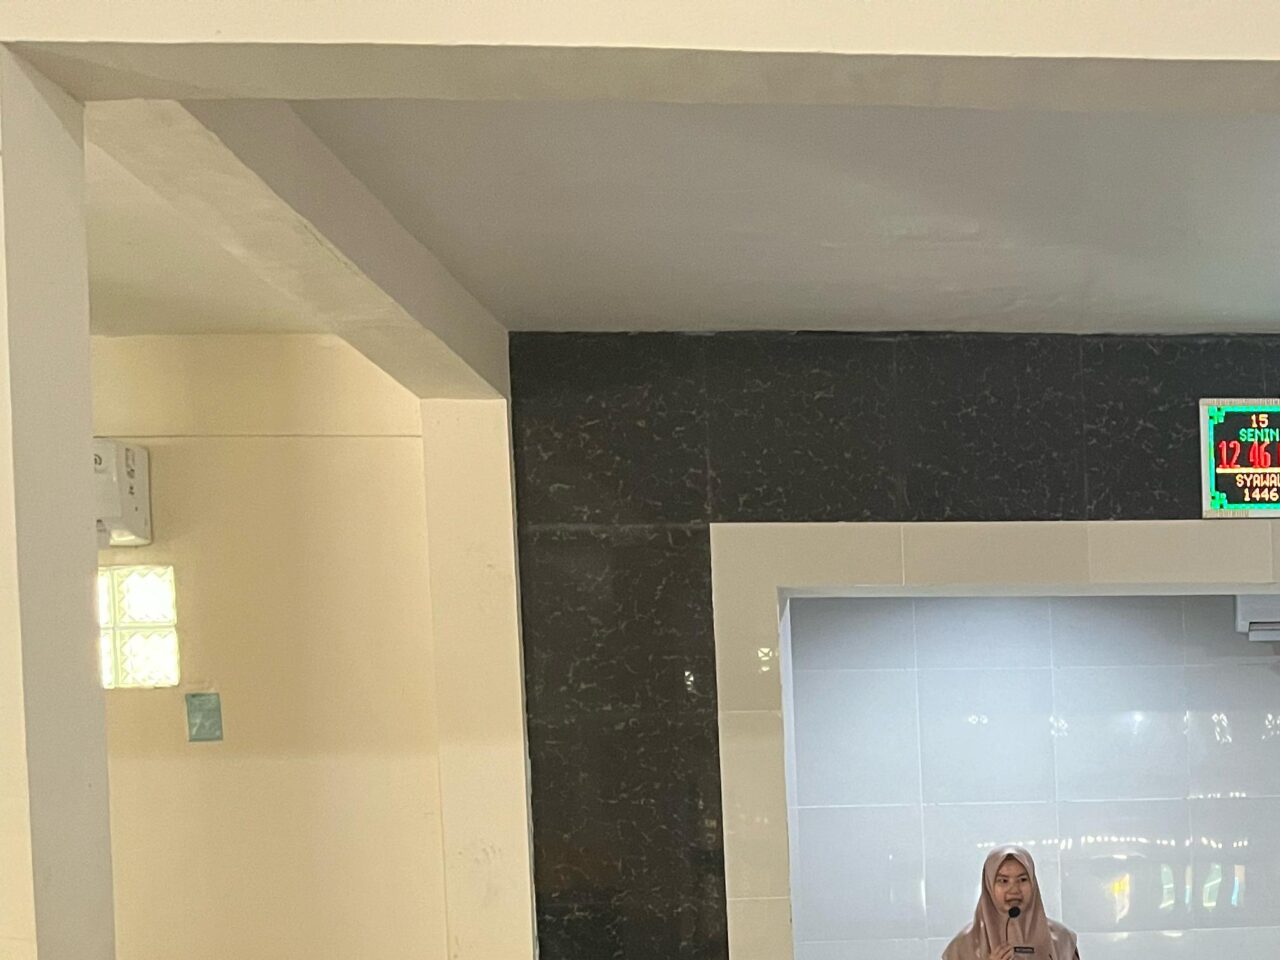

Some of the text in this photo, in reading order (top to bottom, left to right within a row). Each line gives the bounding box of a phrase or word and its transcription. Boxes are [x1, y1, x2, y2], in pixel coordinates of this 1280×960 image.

[1251, 414, 1268, 427] 15
[1239, 428, 1279, 441] SENIN
[1218, 441, 1240, 468] 12
[1244, 488, 1279, 501] 1446
